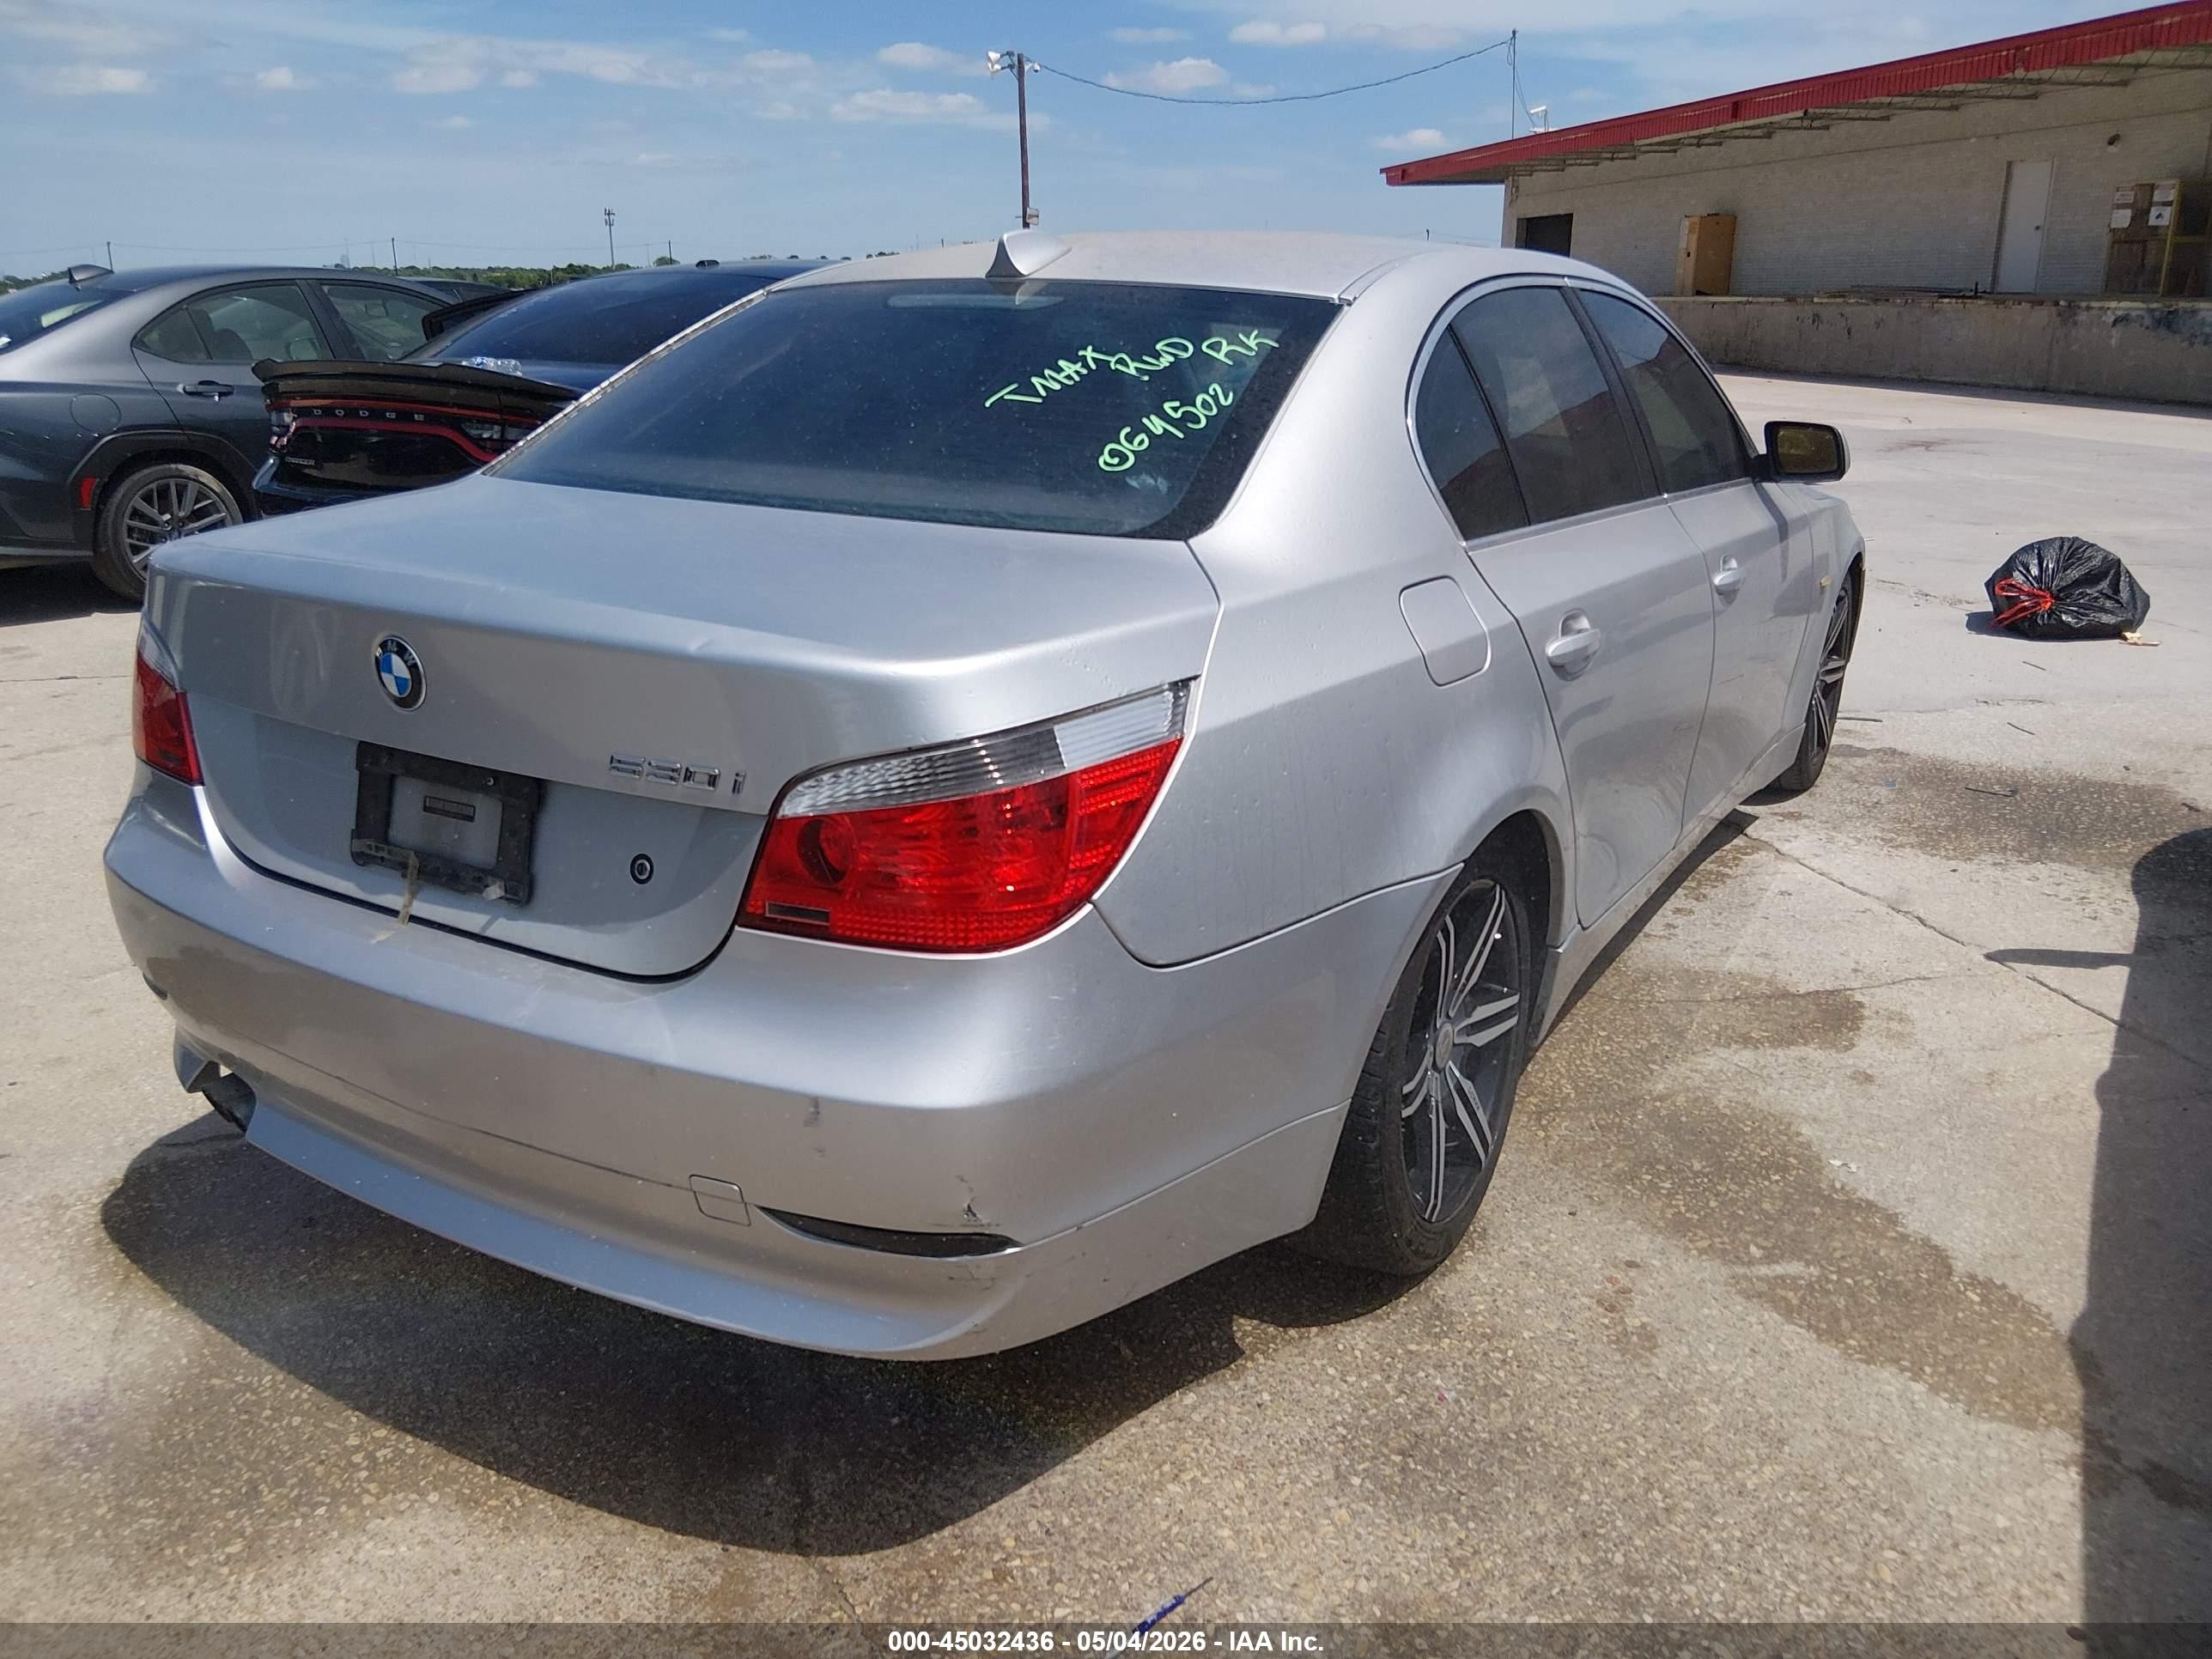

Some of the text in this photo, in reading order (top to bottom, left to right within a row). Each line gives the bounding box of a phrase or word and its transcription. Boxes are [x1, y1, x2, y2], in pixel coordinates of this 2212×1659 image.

[984, 344, 1114, 408] TMAX
[1201, 329, 1280, 366] RK
[313, 408, 425, 422] DODGE
[609, 753, 747, 795] 530i
